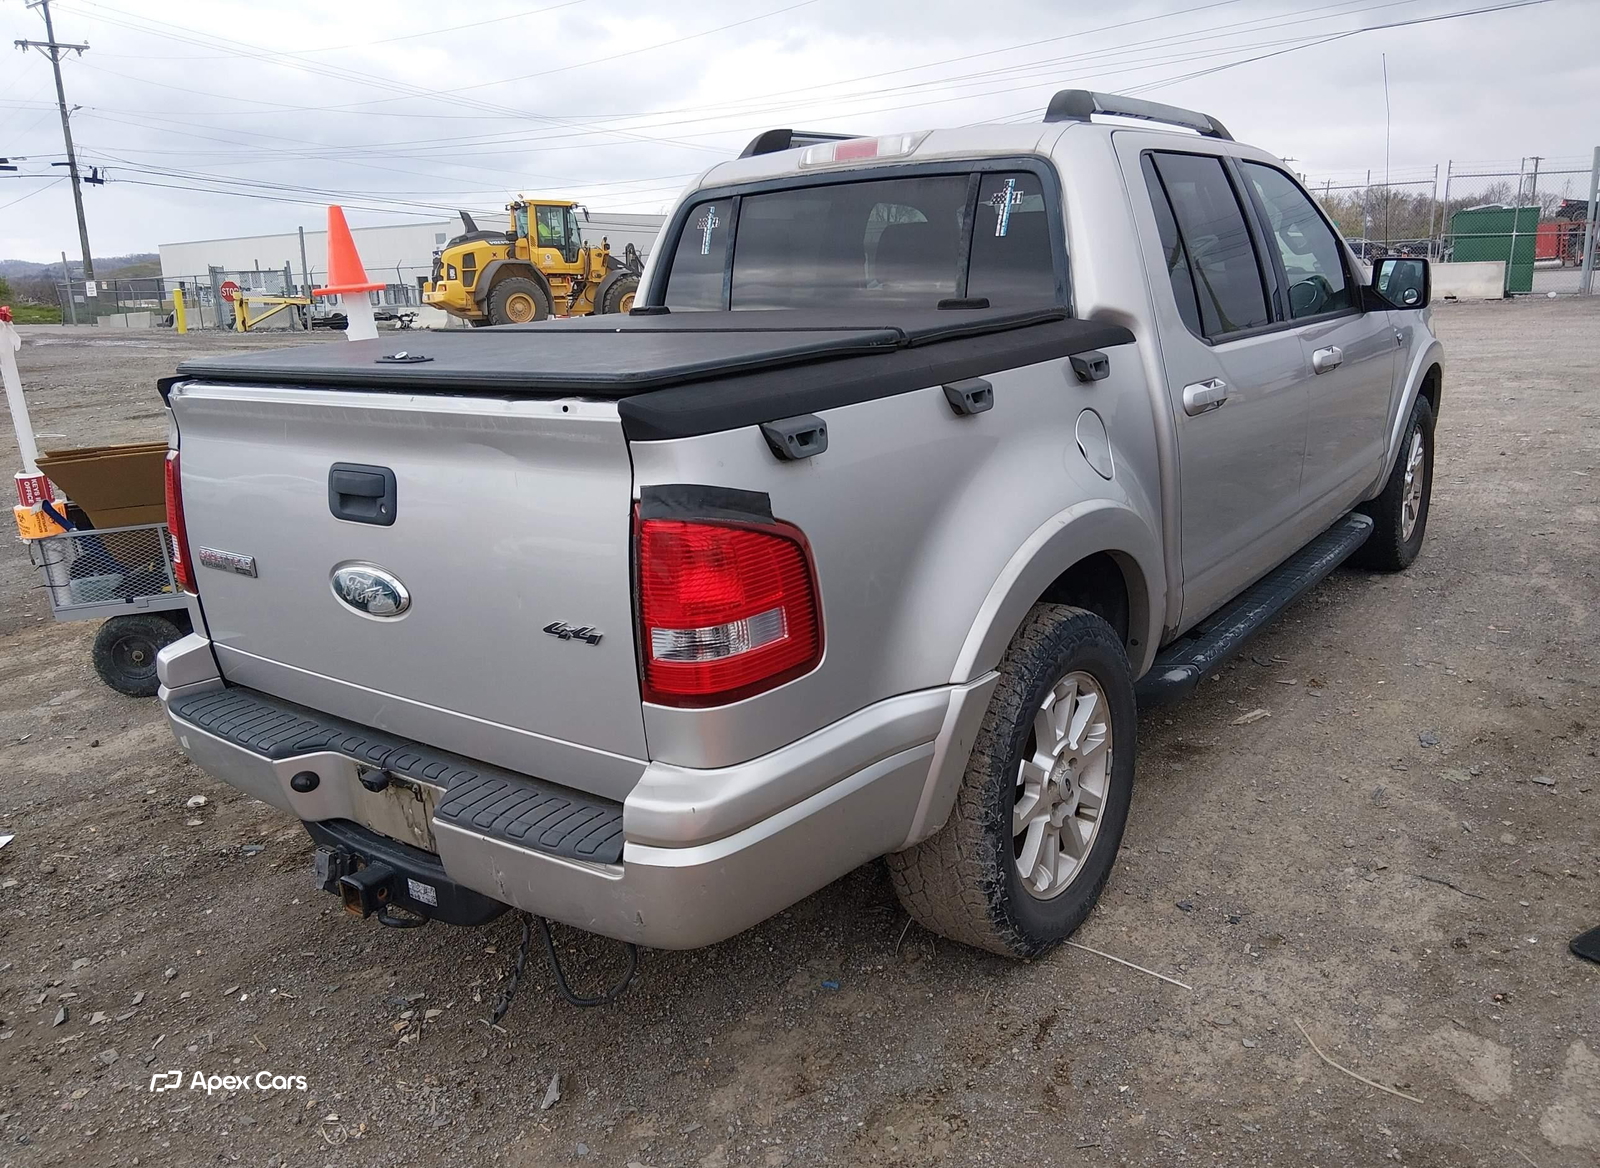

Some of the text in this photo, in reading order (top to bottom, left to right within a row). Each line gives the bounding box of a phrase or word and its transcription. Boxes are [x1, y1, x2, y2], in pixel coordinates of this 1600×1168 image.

[23, 481, 35, 504] OFFICE
[31, 478, 41, 497] KEYS
[342, 574, 393, 606] Ford
